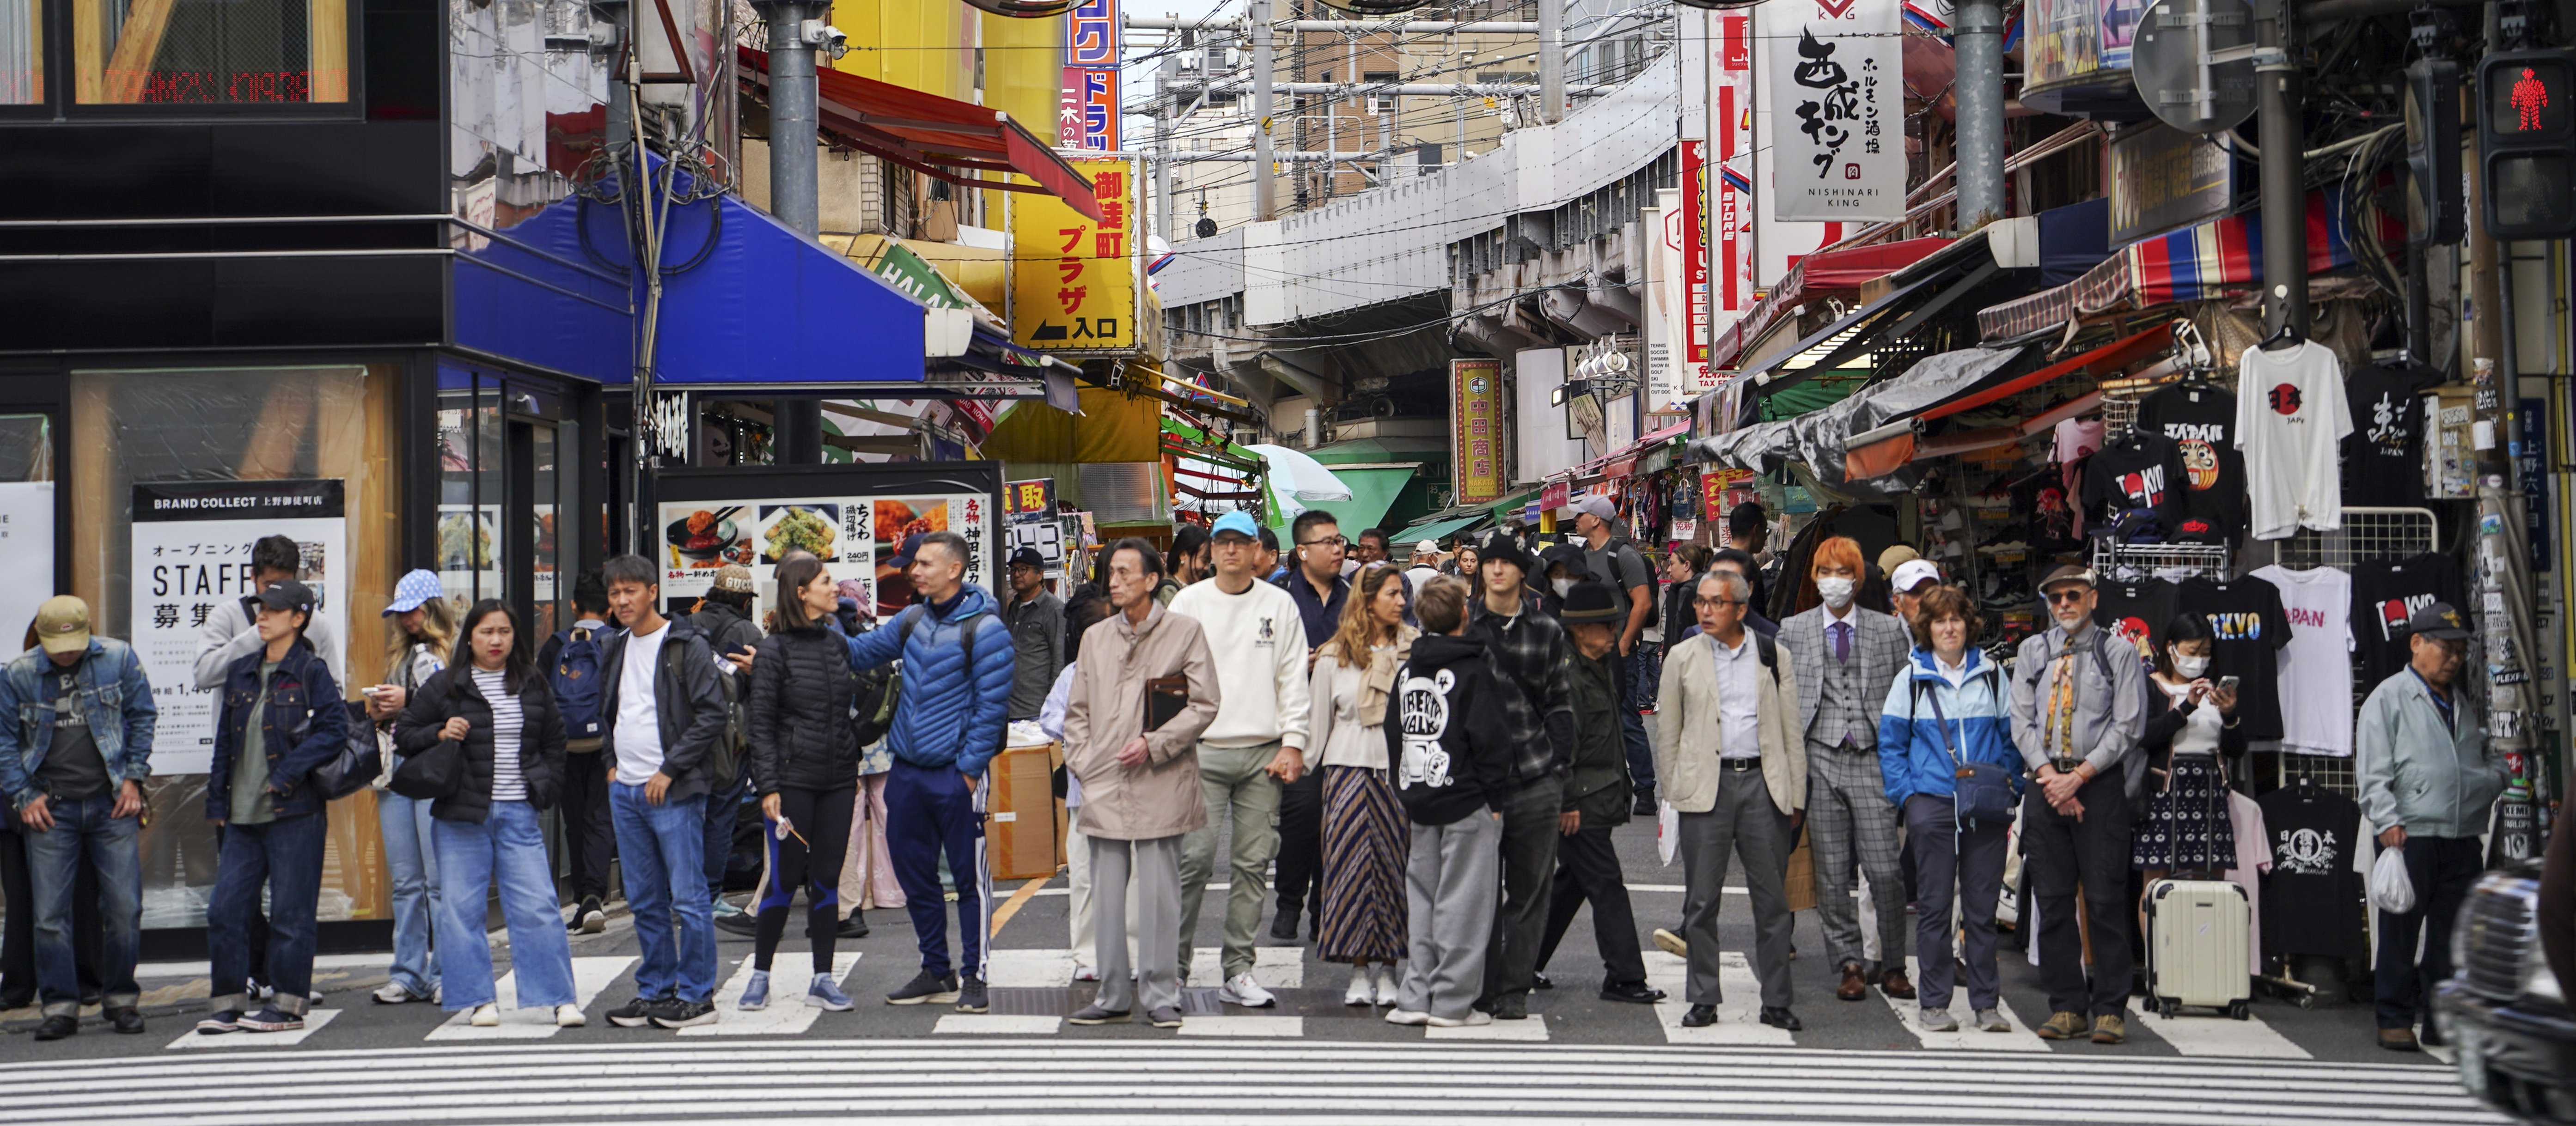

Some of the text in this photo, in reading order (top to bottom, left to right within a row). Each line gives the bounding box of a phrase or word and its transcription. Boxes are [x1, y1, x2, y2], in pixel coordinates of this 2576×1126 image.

[1863, 58, 1880, 154] ホルモン酒場
[1808, 188, 1879, 196] NISHINARI
[1094, 171, 1123, 260] 御徒町
[1722, 192, 1735, 241] STORE
[1057, 225, 1087, 315] プラザ
[1072, 317, 1117, 340] 入口
[1469, 397, 1490, 477] 中田商店
[2164, 423, 2223, 444] JAPAN
[2380, 447, 2404, 456] JAPAN
[2522, 439, 2539, 528] 上野六丁目
[154, 495, 323, 509] BRAND COLLECT 上野御徒町店
[856, 503, 870, 541] ちくわ
[1675, 521, 1693, 531] 免税
[153, 542, 253, 557] オープニング
[153, 563, 253, 597] STAFF
[153, 603, 215, 629] 募集
